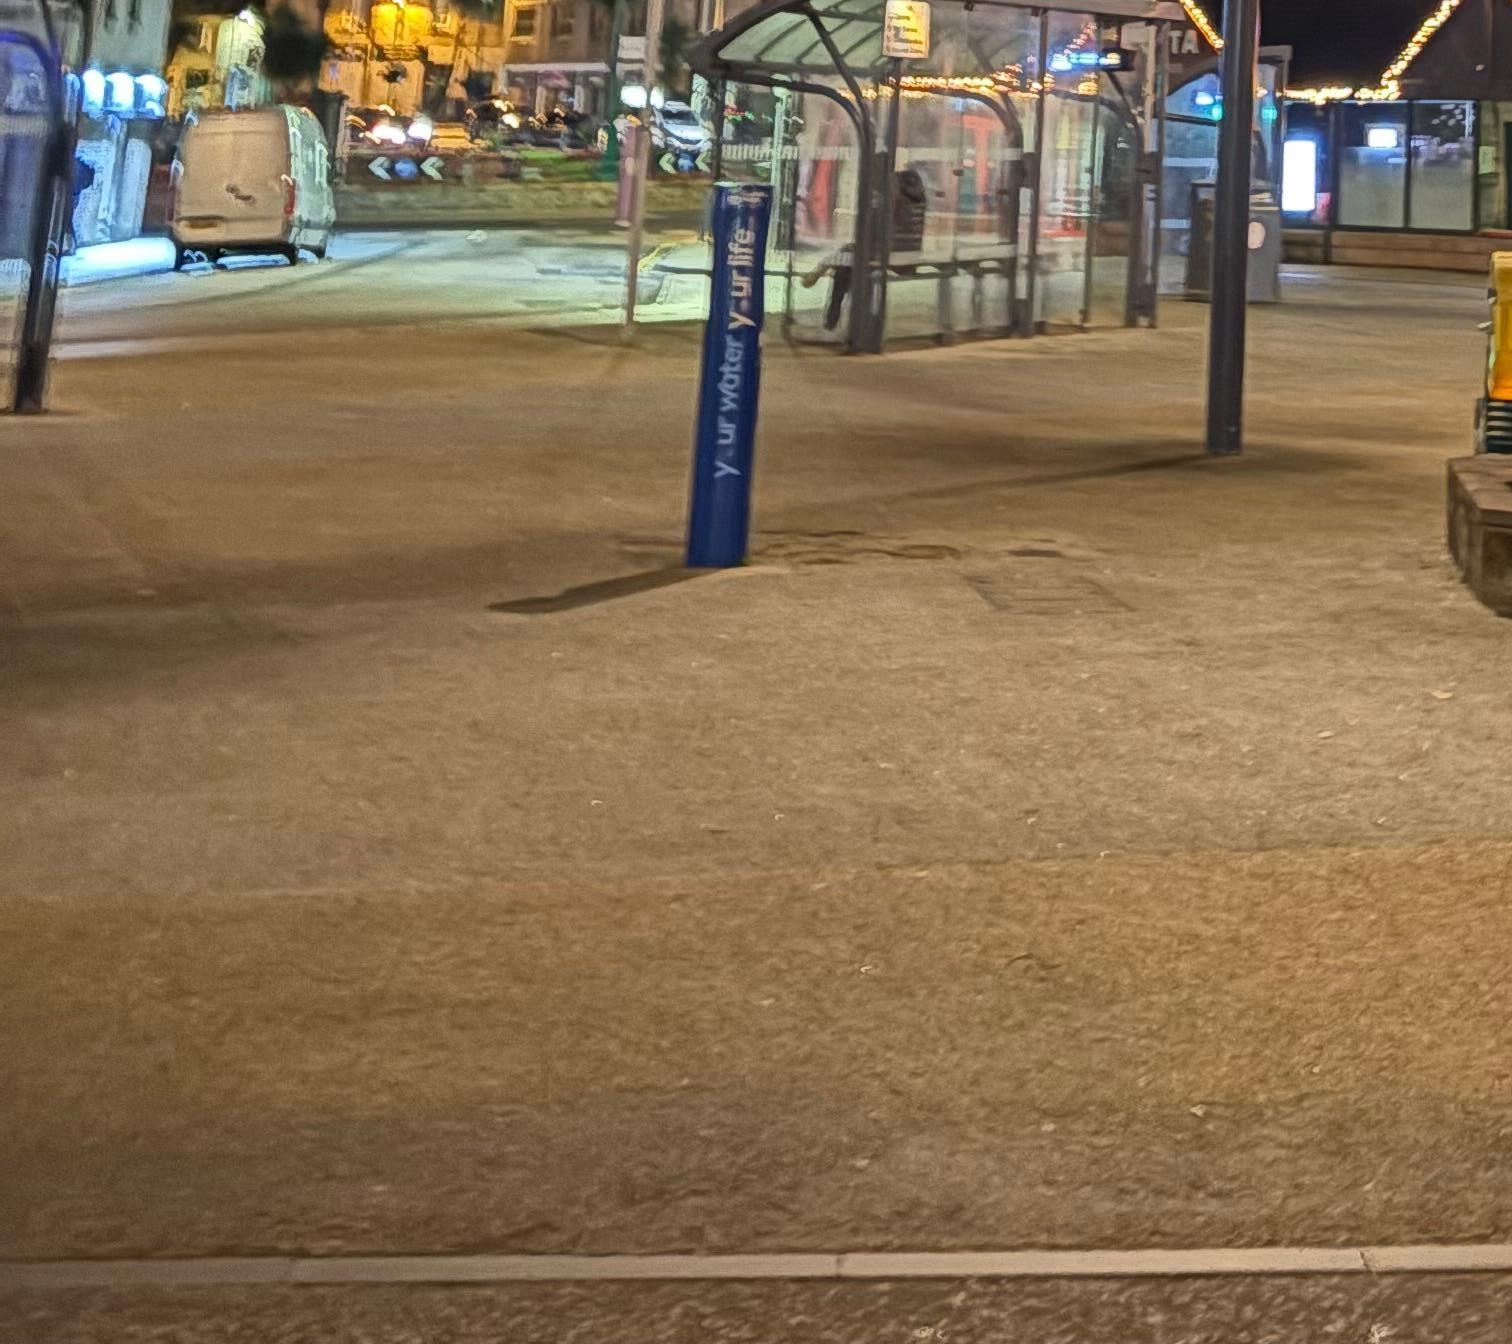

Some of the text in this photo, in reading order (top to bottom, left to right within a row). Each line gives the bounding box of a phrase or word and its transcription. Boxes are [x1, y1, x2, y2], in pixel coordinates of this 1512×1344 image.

[1168, 29, 1200, 54] TA
[727, 228, 756, 267] life
[717, 334, 745, 412] water
[712, 416, 743, 479] yur
